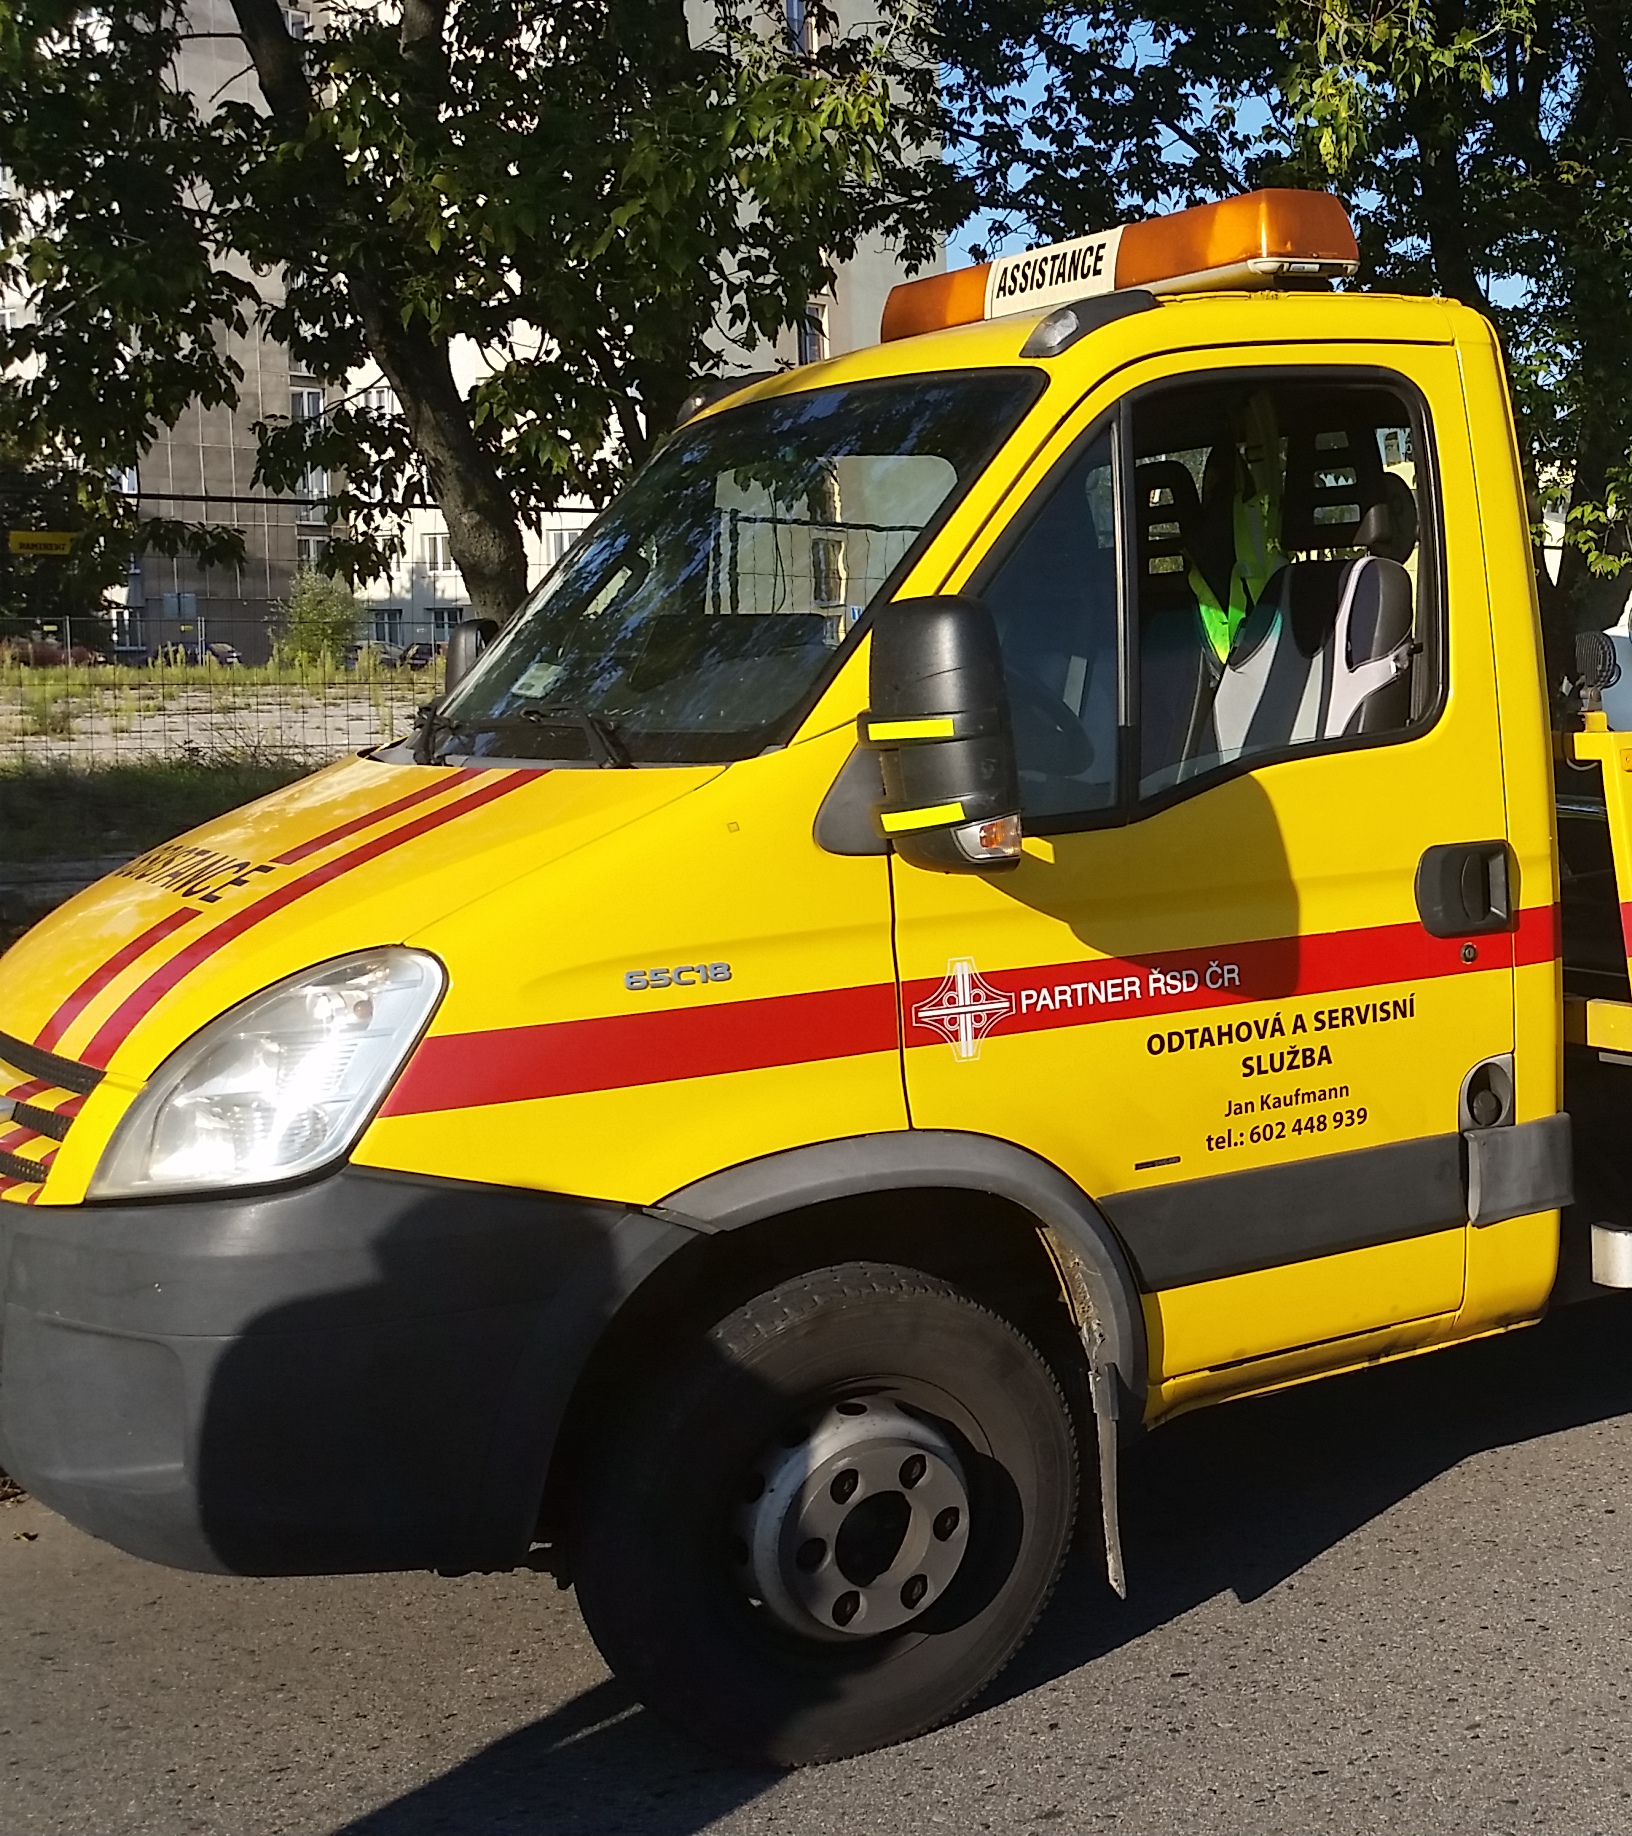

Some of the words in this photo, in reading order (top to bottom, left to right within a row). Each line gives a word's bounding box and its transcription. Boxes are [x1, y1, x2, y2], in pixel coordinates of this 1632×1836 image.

[996, 242, 1107, 299] ASSISTANCE
[114, 844, 277, 904] SSISTANCE
[624, 961, 733, 991] 65C18
[1020, 976, 1141, 1014] PARTNER
[1148, 968, 1199, 997] ŘSD
[1205, 960, 1241, 989] ČR
[1146, 1011, 1286, 1056] ODTAHOVÁ
[1291, 1013, 1308, 1035] A
[1313, 992, 1417, 1032] SERVISNÍ
[1241, 1044, 1333, 1078] SLUŽBA
[1224, 1099, 1255, 1118] Jan
[1260, 1084, 1350, 1112] Kaufmann
[1205, 1128, 1245, 1152] tel.:
[1249, 1121, 1287, 1144] 602
[1291, 1114, 1328, 1136] 448
[1332, 1107, 1368, 1130] 939
